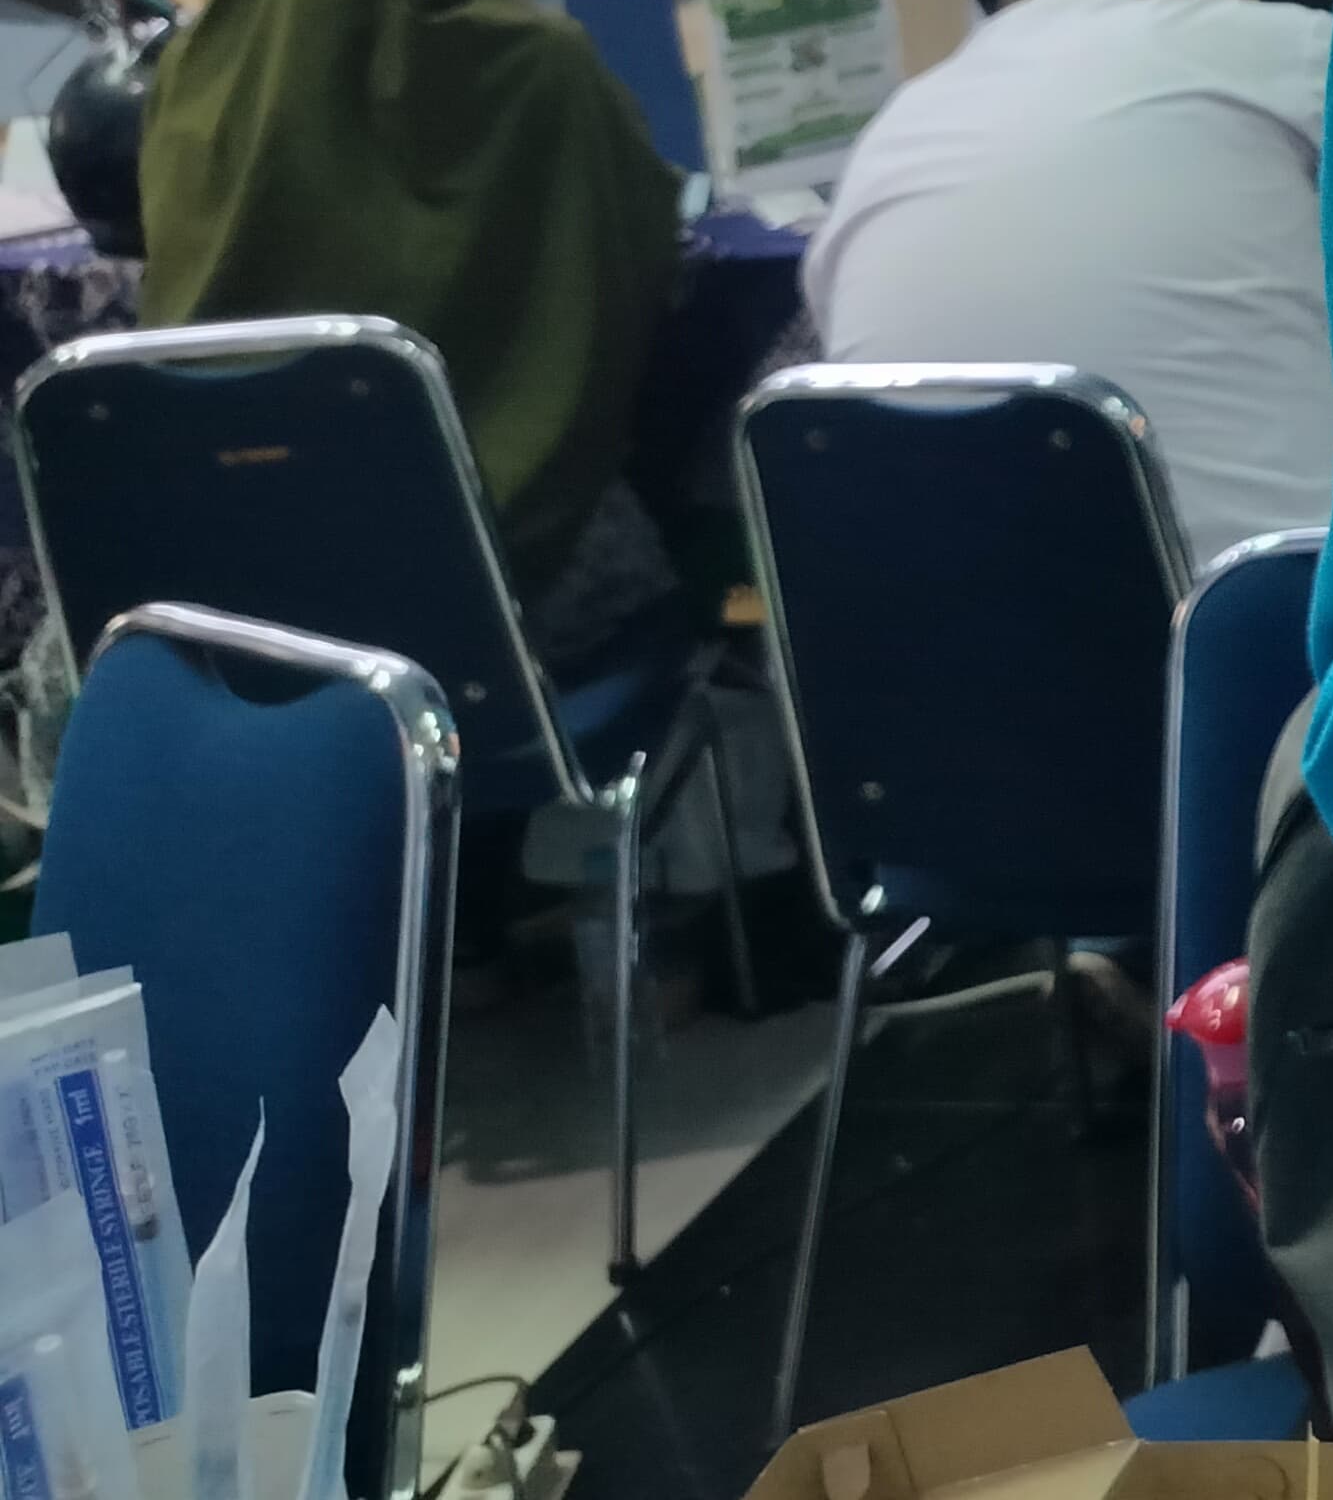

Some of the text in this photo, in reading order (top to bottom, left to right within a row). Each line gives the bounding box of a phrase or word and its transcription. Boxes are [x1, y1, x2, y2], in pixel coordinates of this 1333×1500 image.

[68, 1088, 94, 1126] 1ml
[84, 1142, 118, 1238] SYRINGE
[103, 1243, 139, 1329] STERILE
